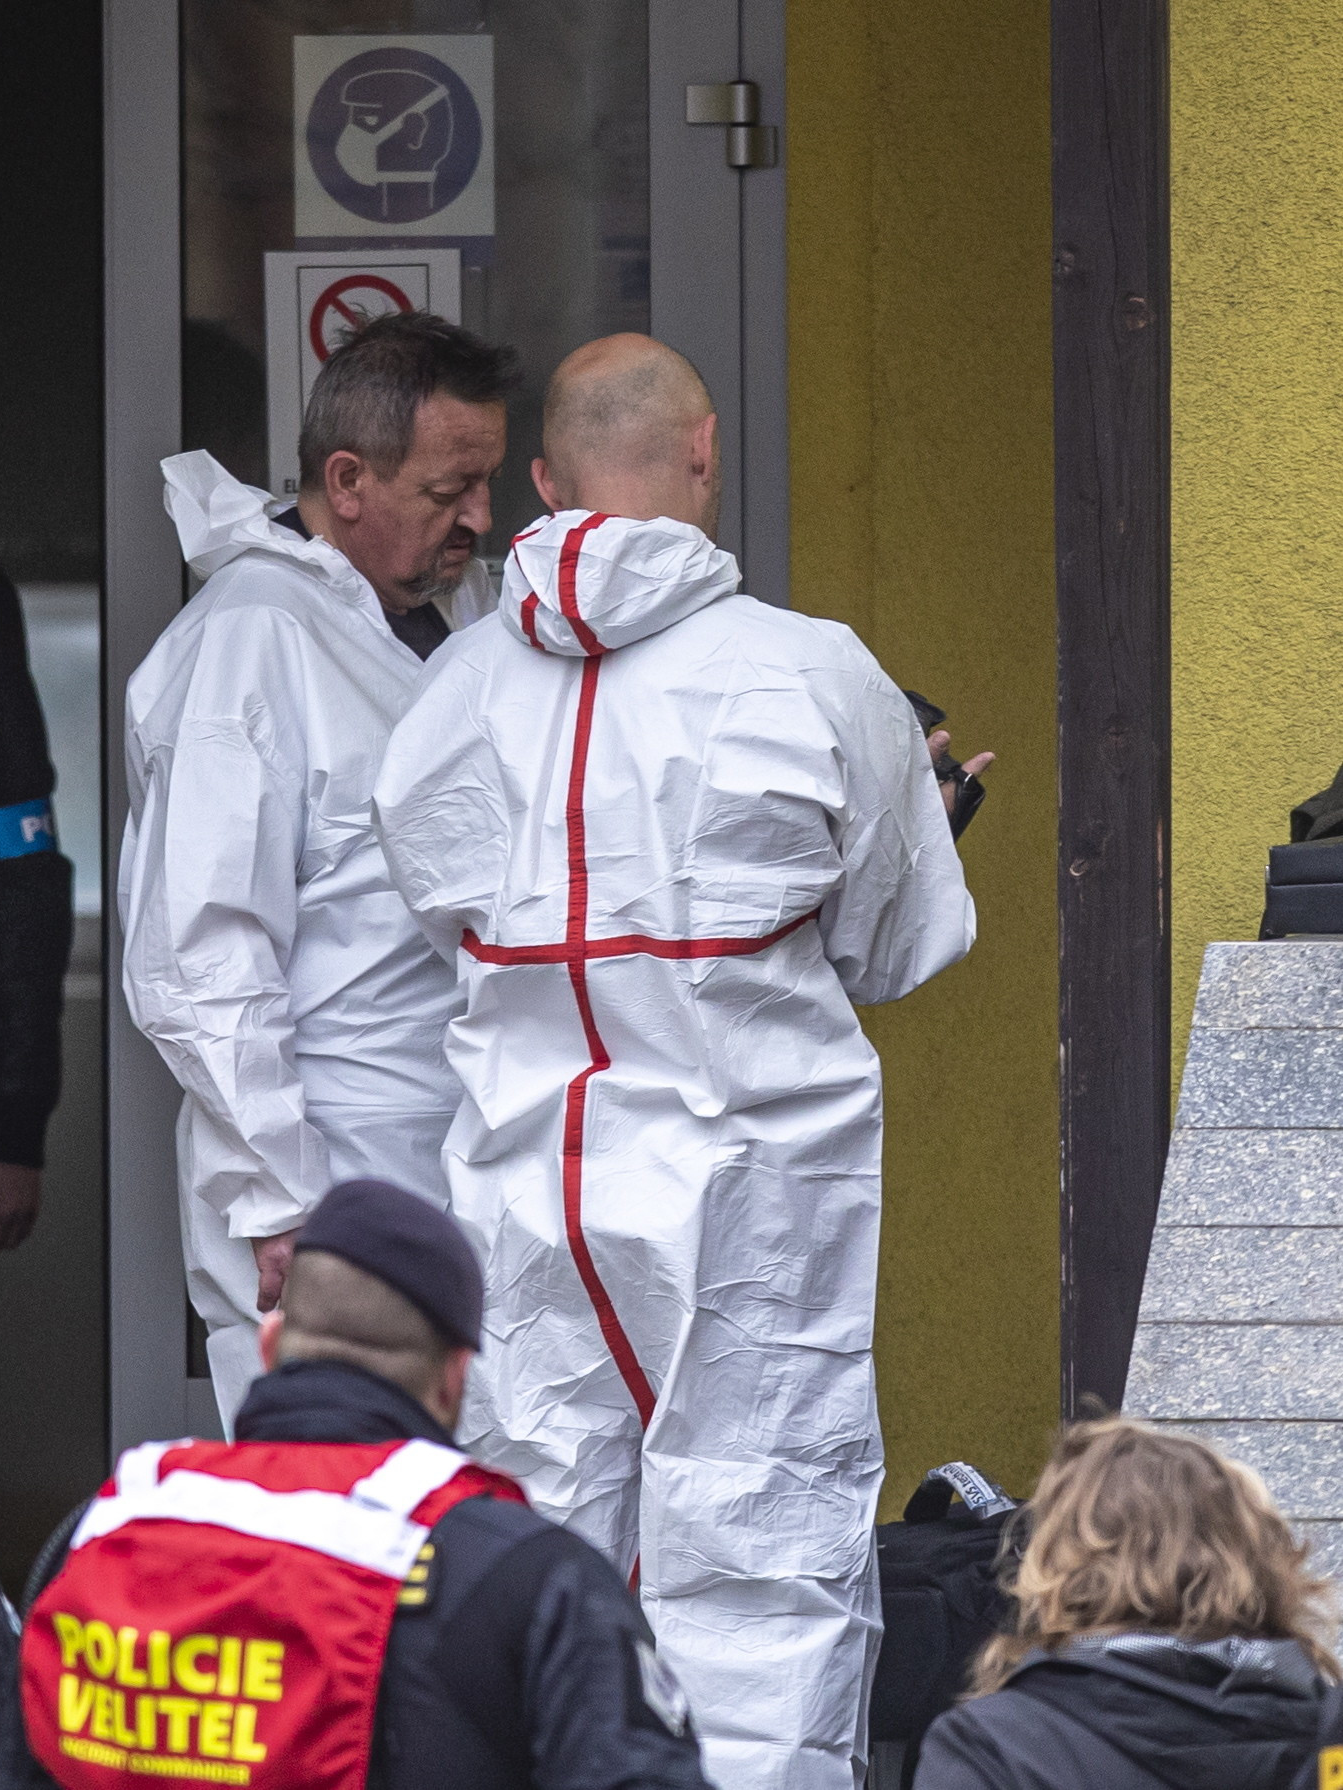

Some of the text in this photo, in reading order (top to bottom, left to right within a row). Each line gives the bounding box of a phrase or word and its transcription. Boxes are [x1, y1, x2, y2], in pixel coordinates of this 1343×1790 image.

[283, 479, 300, 494] EL
[52, 1611, 285, 1702] POLICIE
[59, 1672, 267, 1763] VELITEL
